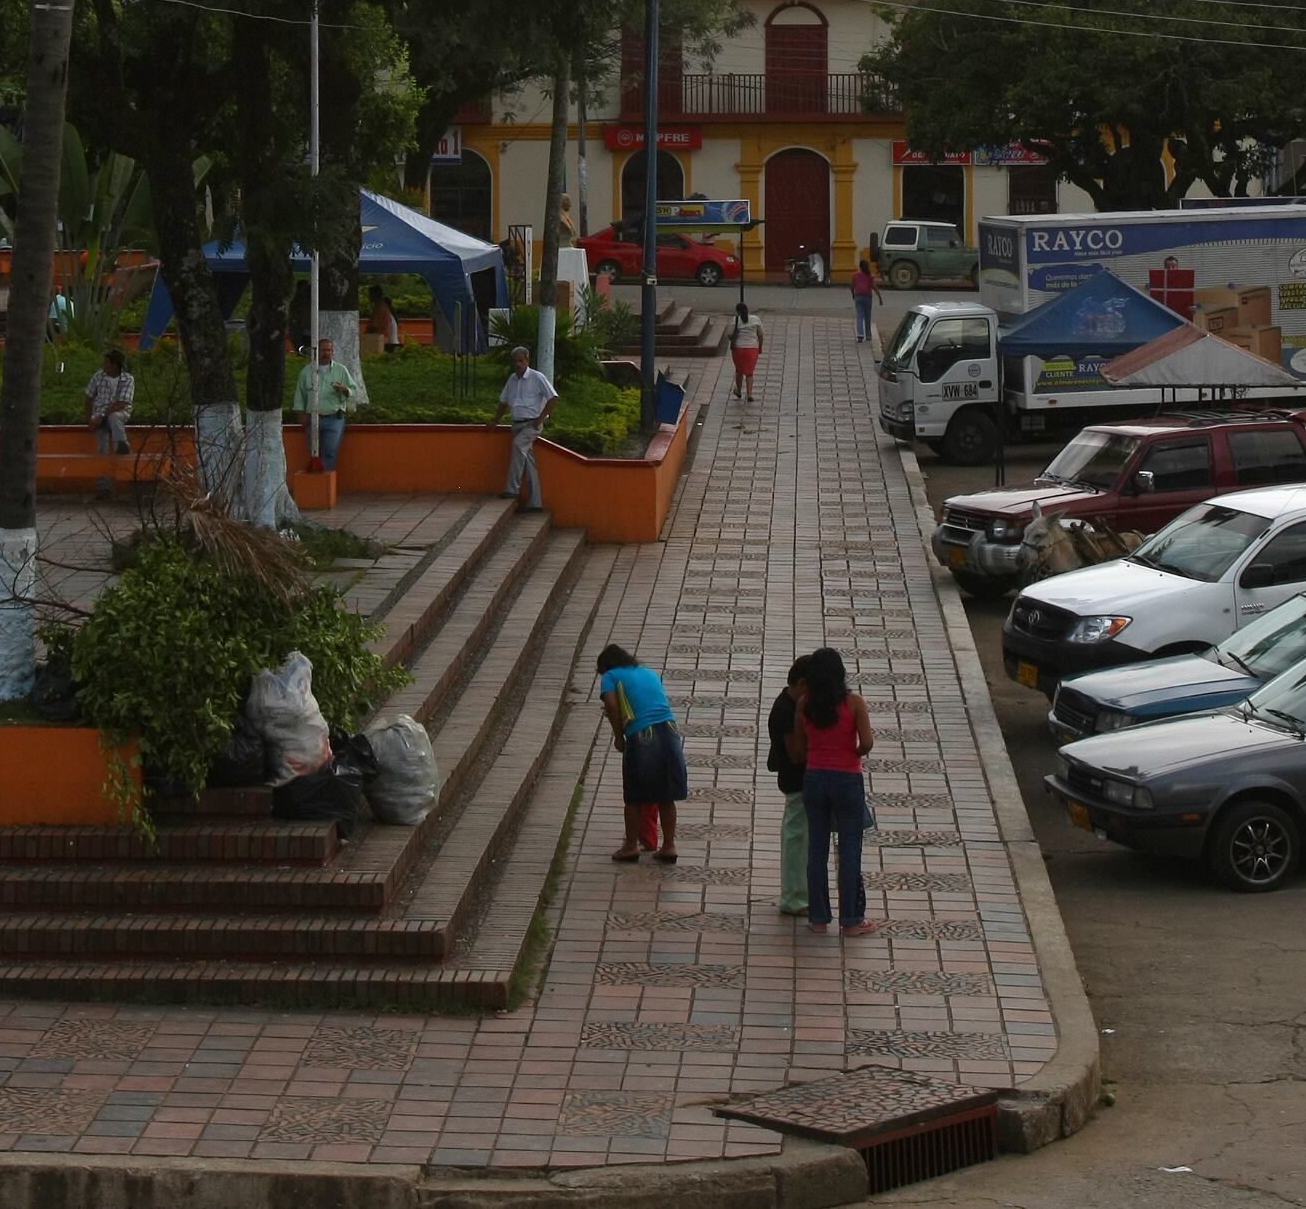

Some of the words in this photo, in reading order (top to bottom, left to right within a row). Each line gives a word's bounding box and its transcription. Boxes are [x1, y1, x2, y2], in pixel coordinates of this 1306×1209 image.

[635, 133, 690, 142] MPFRE
[988, 234, 1012, 258] RAYCO
[1032, 229, 1123, 252] RAYCO
[943, 384, 961, 399] XVW
[964, 383, 978, 397] 684
